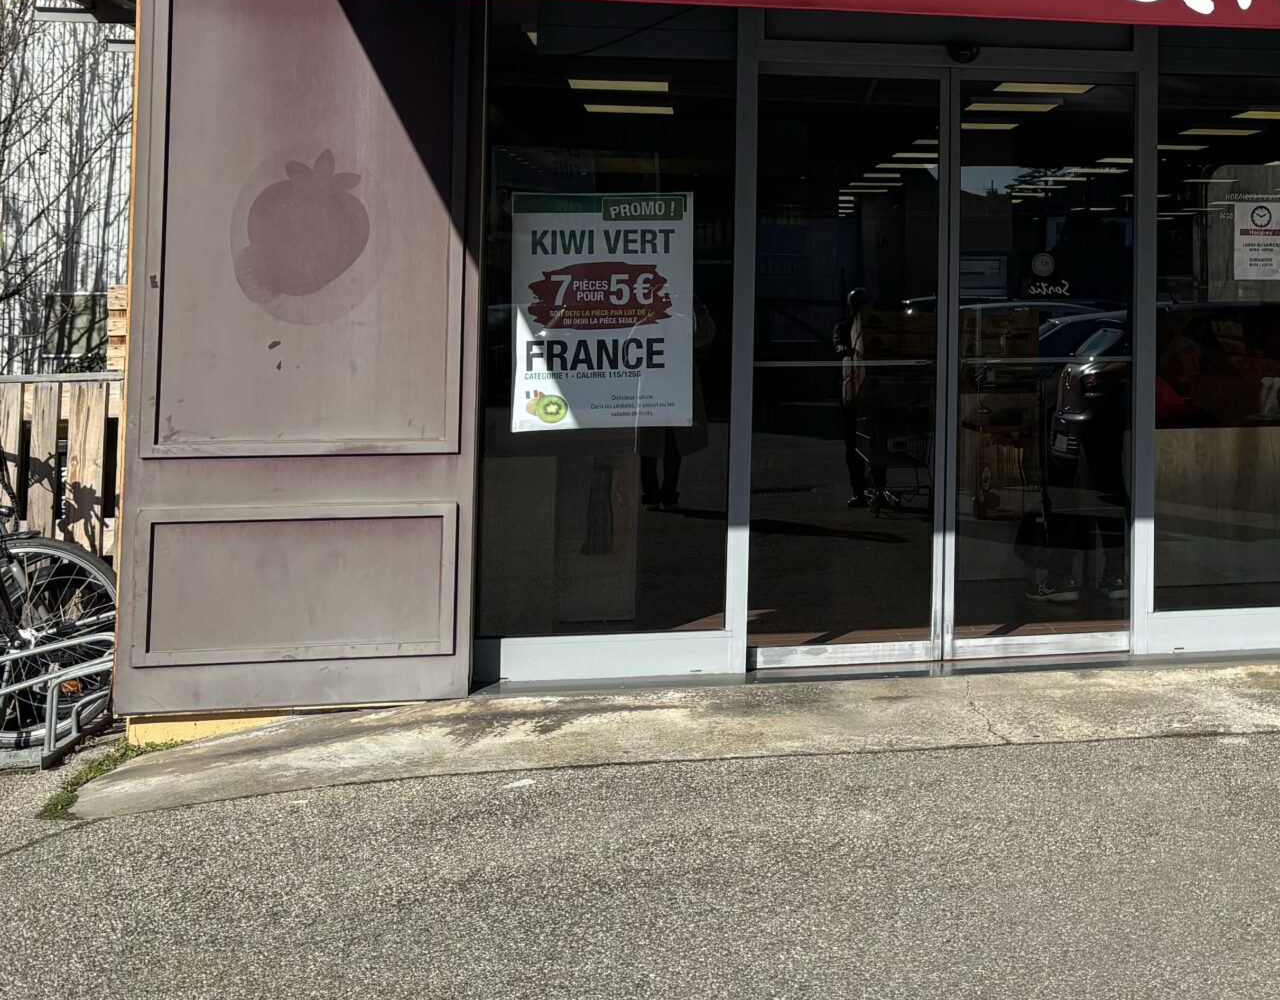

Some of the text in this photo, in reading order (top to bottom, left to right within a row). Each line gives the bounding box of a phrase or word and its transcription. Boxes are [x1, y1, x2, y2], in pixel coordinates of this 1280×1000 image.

[610, 201, 675, 218] PROMO !
[531, 229, 675, 255] KIWI VERT
[551, 275, 572, 306] 7
[573, 278, 608, 291] PIÈCES
[577, 291, 604, 301] POUR
[610, 308, 622, 316] PAR
[525, 338, 665, 371] FRANCE
[524, 371, 562, 380] CATÉGORIE
[577, 371, 607, 379] CALIBRE
